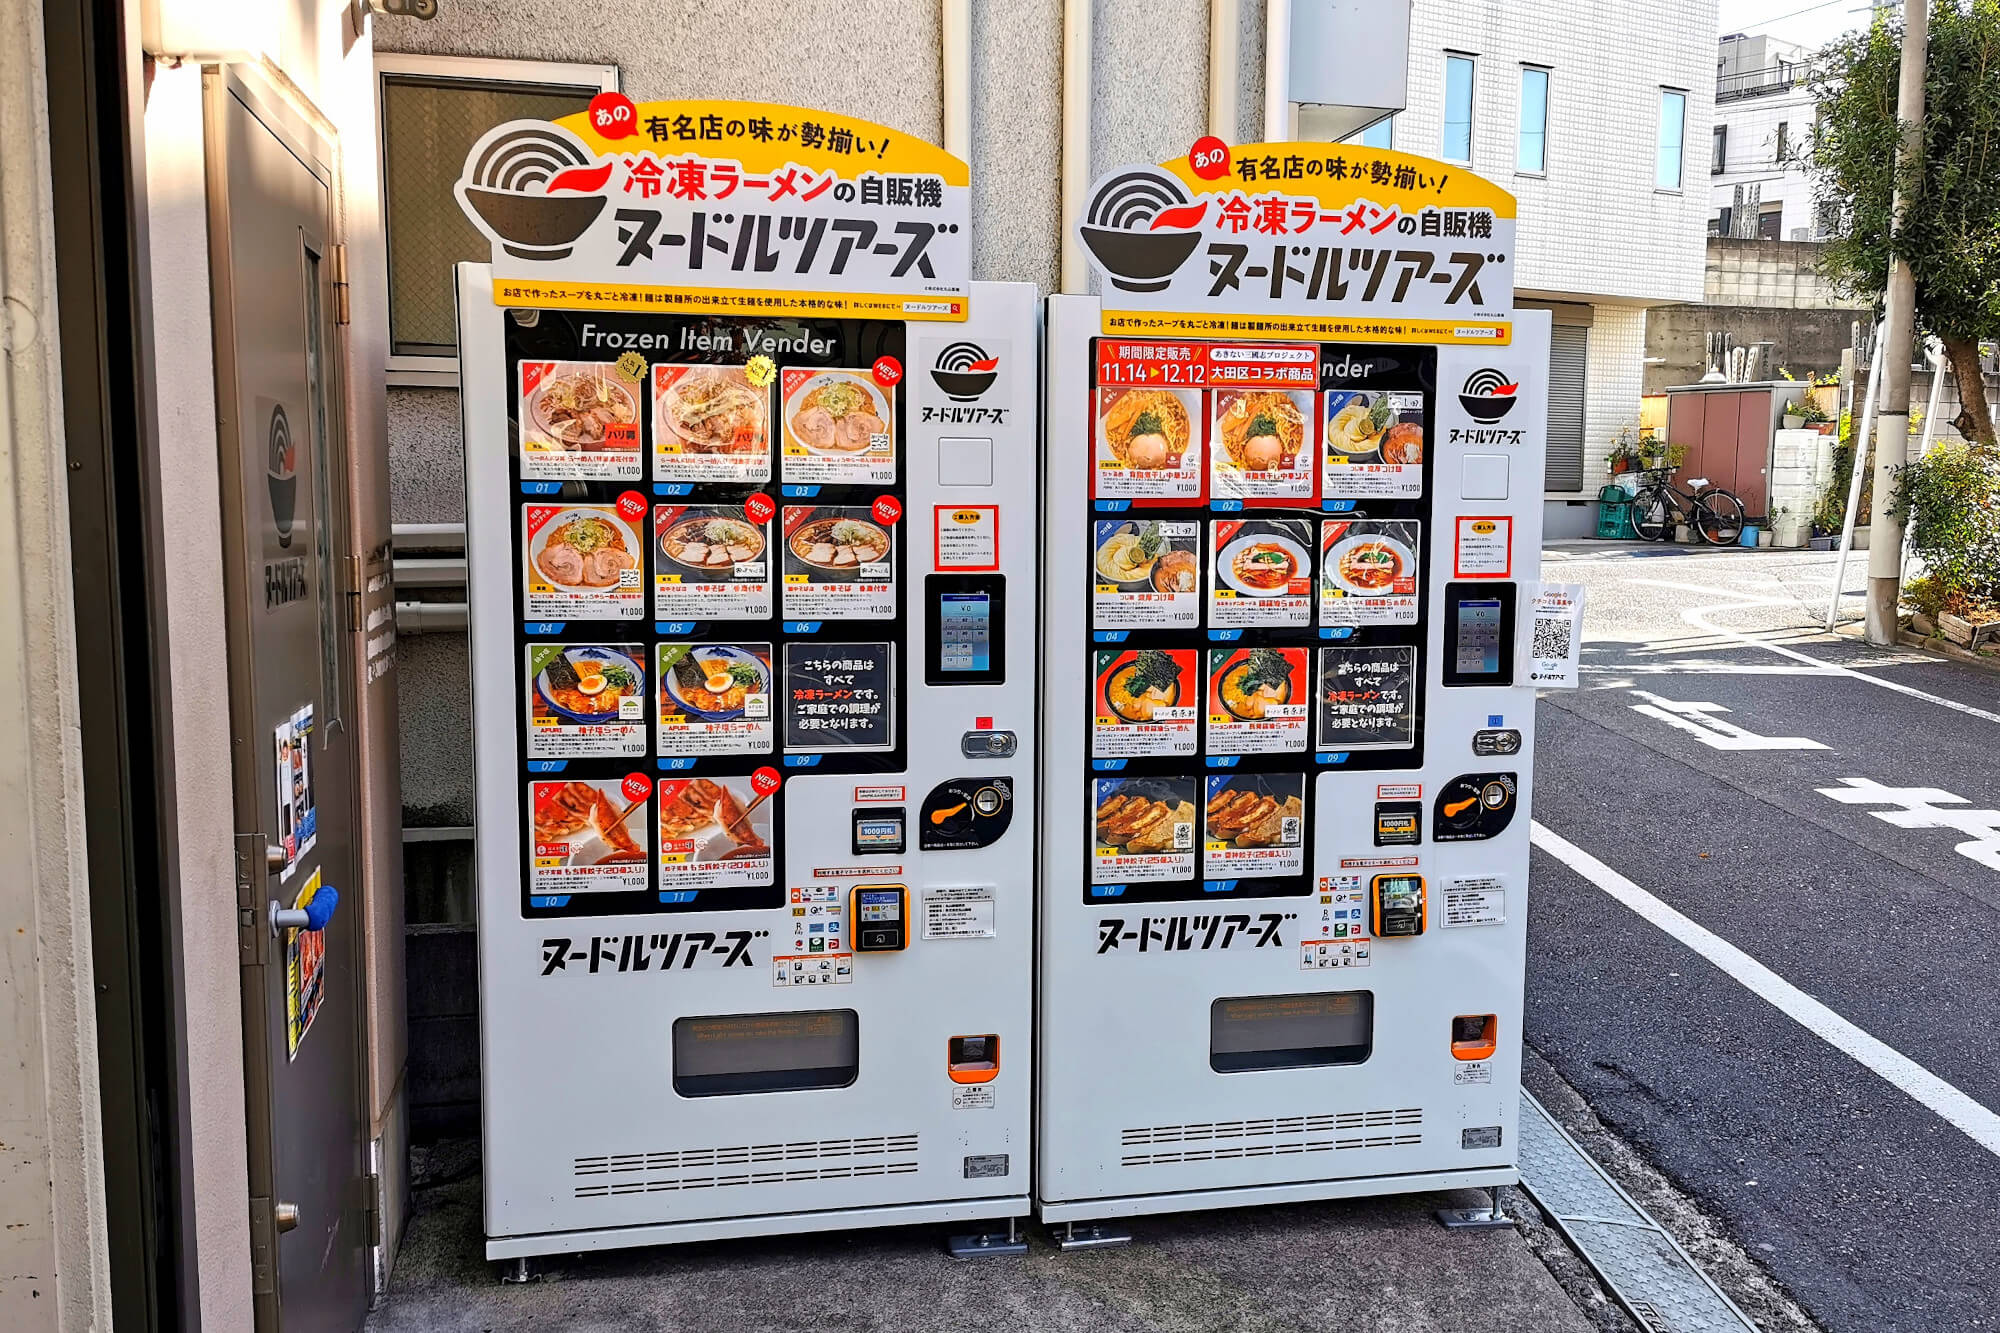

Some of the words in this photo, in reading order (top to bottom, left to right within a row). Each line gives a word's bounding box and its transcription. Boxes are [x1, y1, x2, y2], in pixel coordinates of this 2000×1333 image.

[595, 103, 630, 127] あの
[644, 114, 891, 159] 有名店の味が勢揃い！
[1194, 147, 1224, 166] あの
[1236, 155, 1449, 195] 有名店の味が勢揃い！
[622, 156, 943, 209] 冷凍ラーメンの自販機
[1215, 196, 1492, 240] 冷凍ラーメンの自販機
[613, 207, 960, 281] ヌードルツアーズ
[1206, 242, 1506, 305] ヌードルツアーズ
[581, 324, 670, 350] Frozen
[679, 327, 734, 352] Item
[744, 328, 837, 355] Vender
[1118, 345, 1191, 361] 期間限定販売
[876, 361, 900, 379] NEW
[1322, 354, 1373, 379] nder
[1102, 363, 1147, 383] 11.14
[1161, 364, 1205, 384] 12.12
[1211, 367, 1314, 381] 大田区コラボ商品
[921, 406, 1010, 424] ヌードルツアーズ
[1449, 429, 1527, 445] ヌードルツアーズ
[617, 466, 641, 476] ¥1,000
[1367, 465, 1403, 473] 濃厚つけ麺
[870, 471, 893, 480] ¥1,000
[535, 484, 549, 493] 01
[667, 485, 681, 494] 02
[795, 486, 808, 496] 03
[1176, 483, 1197, 492] ¥1,000
[1401, 483, 1421, 493] ¥1,000
[619, 497, 645, 513] NEW
[748, 500, 773, 515] NEW
[875, 501, 899, 517] NEW
[1107, 502, 1119, 510] 01
[1222, 501, 1234, 510] 02
[1333, 501, 1345, 510] 03
[1138, 593, 1175, 601] 濃厚つけ麺
[620, 607, 643, 616] ¥1,000
[745, 605, 768, 614] ¥1,000
[870, 605, 892, 614] ¥1,000
[1173, 612, 1194, 621] ¥1,000
[1289, 612, 1309, 621] ¥1,000
[1395, 611, 1414, 619] ¥1,000
[538, 624, 553, 633] 04
[668, 624, 682, 633] 05
[796, 623, 810, 632] 06
[1105, 632, 1118, 641] 04
[1219, 631, 1232, 640] 05
[1330, 629, 1342, 638] 06
[804, 659, 875, 672] こちらの商品は
[1338, 662, 1400, 676] こちらの商品は
[823, 675, 855, 686] すべて
[1354, 676, 1381, 686] すべて
[793, 689, 880, 701] 冷凍ラーメンです。
[1327, 690, 1402, 702] 冷凍ラーメンです。
[797, 703, 881, 715] ご家庭での調理が
[1330, 704, 1404, 715] ご家庭での調理が
[798, 718, 874, 730] 必要となります。
[1331, 718, 1398, 729] 必要となります。
[578, 726, 637, 734] 柚子塩らーめん
[622, 743, 645, 753] ¥1,000
[748, 740, 770, 749] ¥1,000
[1173, 742, 1195, 751] ¥1,000
[1285, 740, 1305, 748] ¥1,000
[797, 756, 810, 765] 09
[1217, 757, 1229, 766] 08
[1327, 754, 1339, 763] 09
[541, 761, 555, 770] 07
[671, 759, 684, 769] 08
[1104, 760, 1117, 769] 07
[624, 778, 649, 794] NEW
[754, 773, 779, 789] NEW
[1383, 820, 1410, 828] 1000円札
[863, 827, 894, 835] 1000円札
[1279, 859, 1299, 868] ¥1,000
[1171, 866, 1192, 875] ¥1,000
[747, 871, 769, 881] ¥1,000
[622, 877, 645, 887] ¥1,000
[1216, 882, 1227, 890] 11
[1103, 887, 1115, 895] 10
[545, 896, 558, 906] 10
[673, 892, 685, 902] 11
[1097, 913, 1298, 954] ヌードルツアーズ
[541, 930, 770, 976] ヌードルツアーズ
